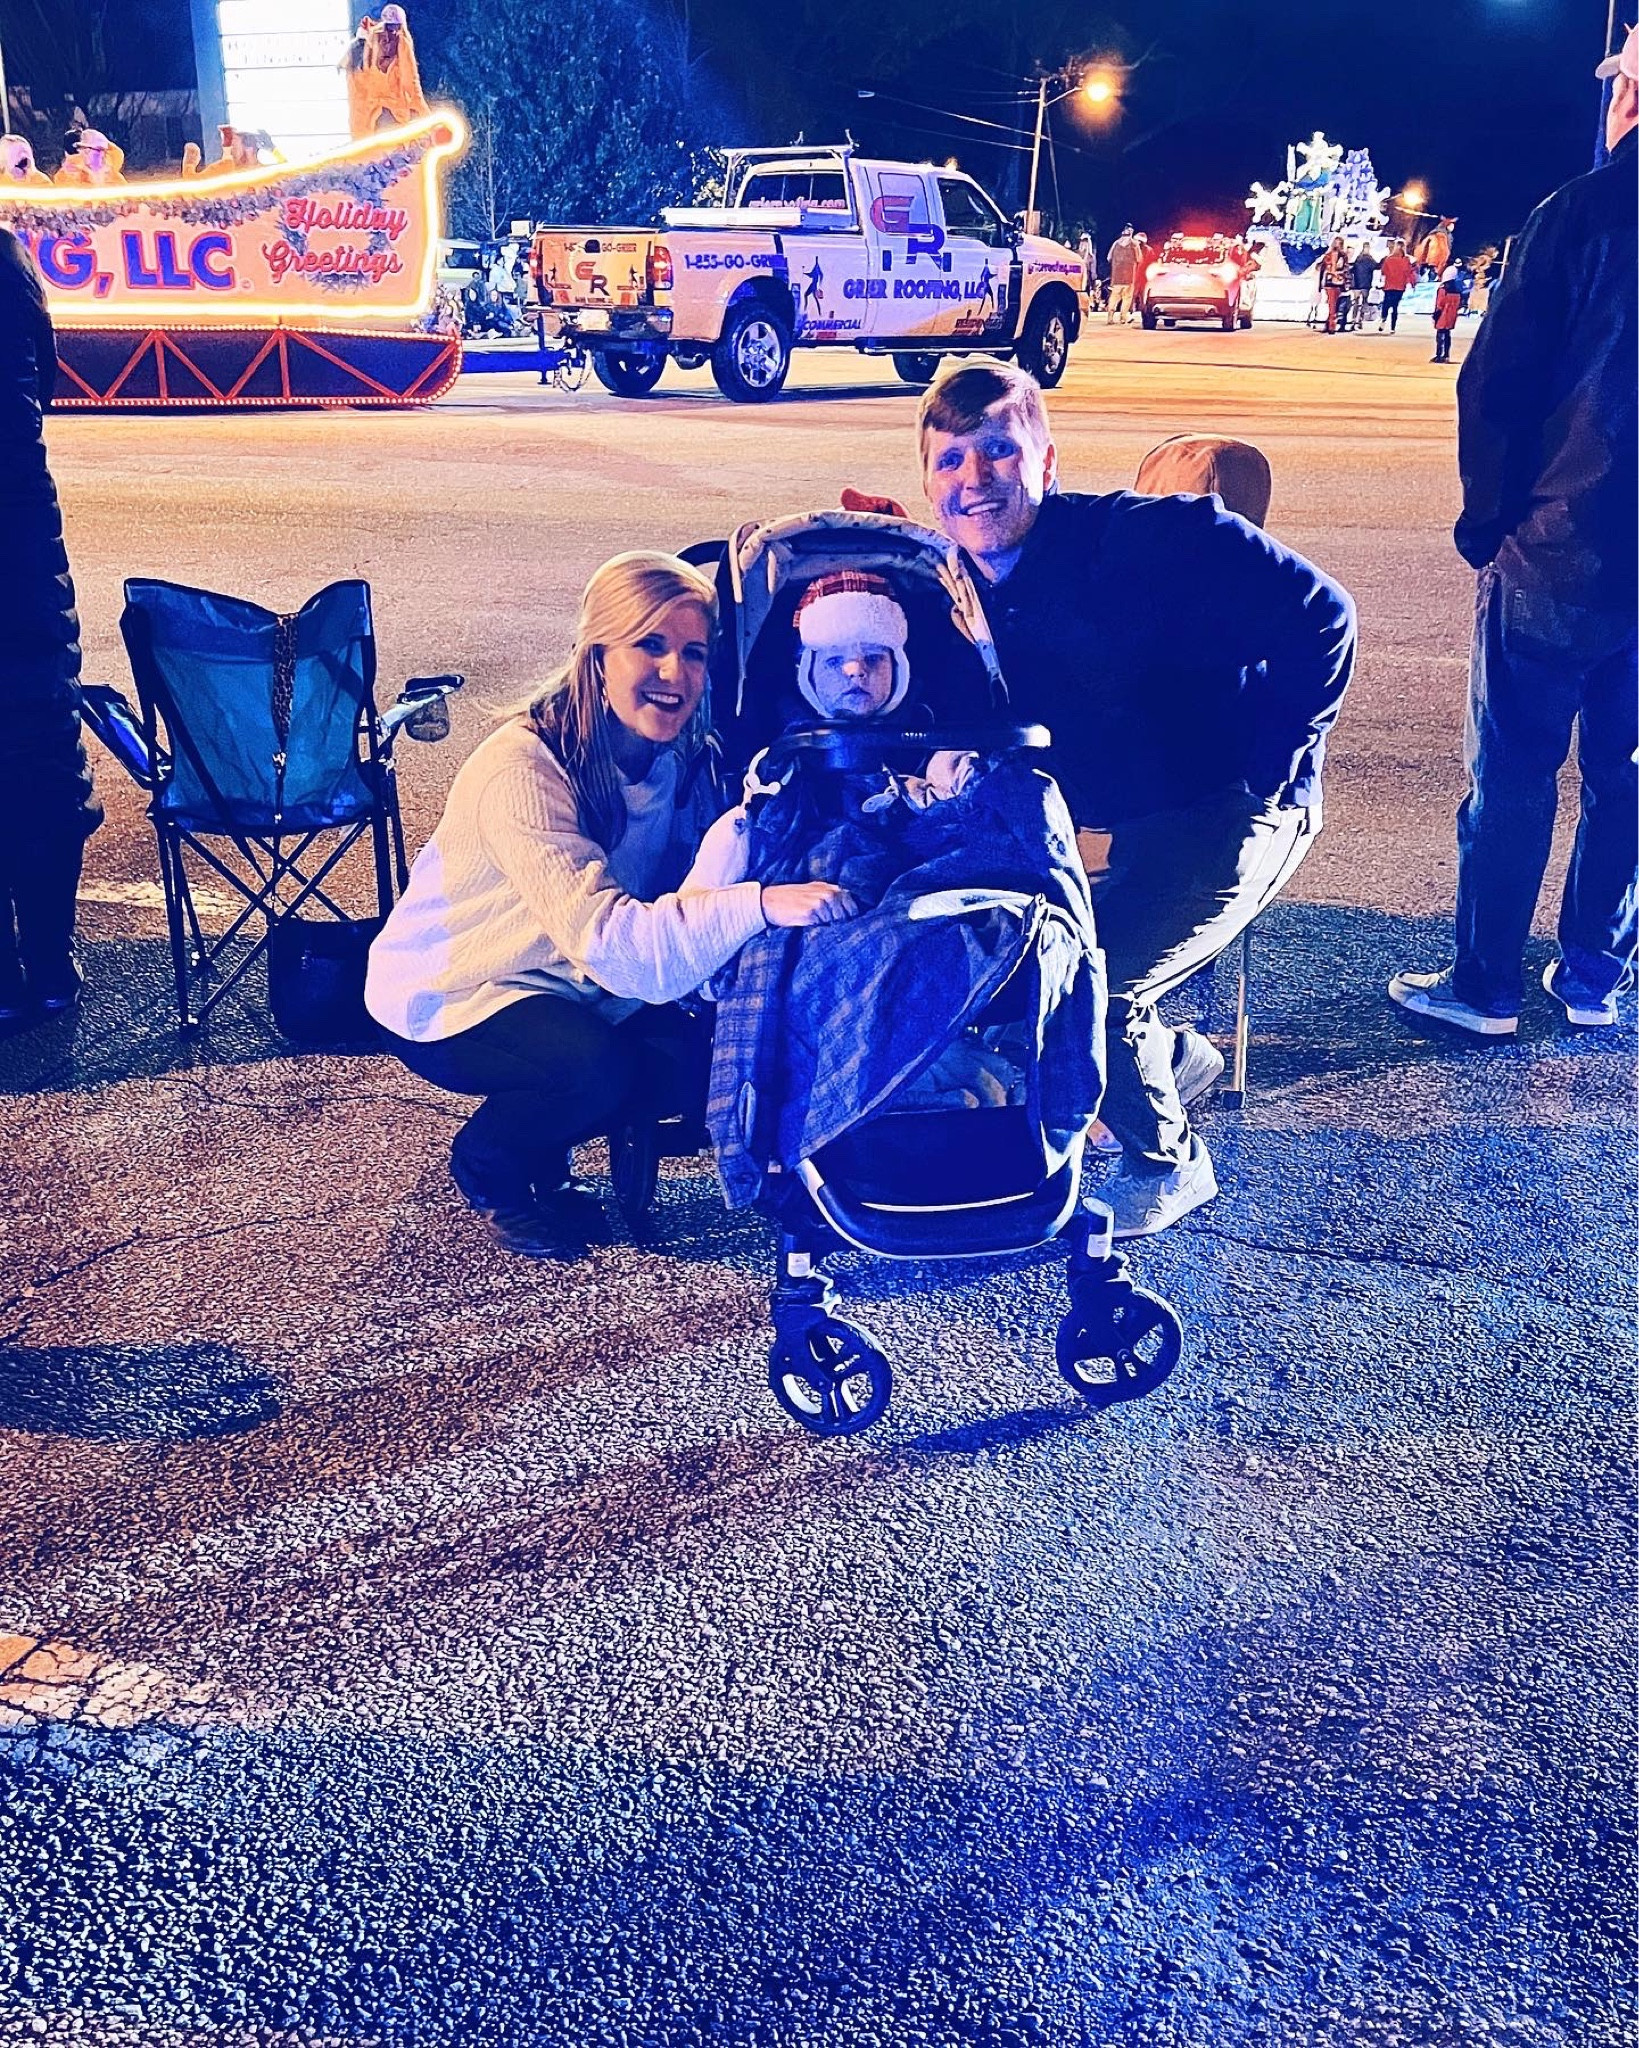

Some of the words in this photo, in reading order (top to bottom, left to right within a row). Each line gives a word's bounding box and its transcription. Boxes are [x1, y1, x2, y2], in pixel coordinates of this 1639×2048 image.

[286, 198, 407, 240] Holiday
[121, 230, 235, 290] LLC
[262, 240, 403, 283] Greetings
